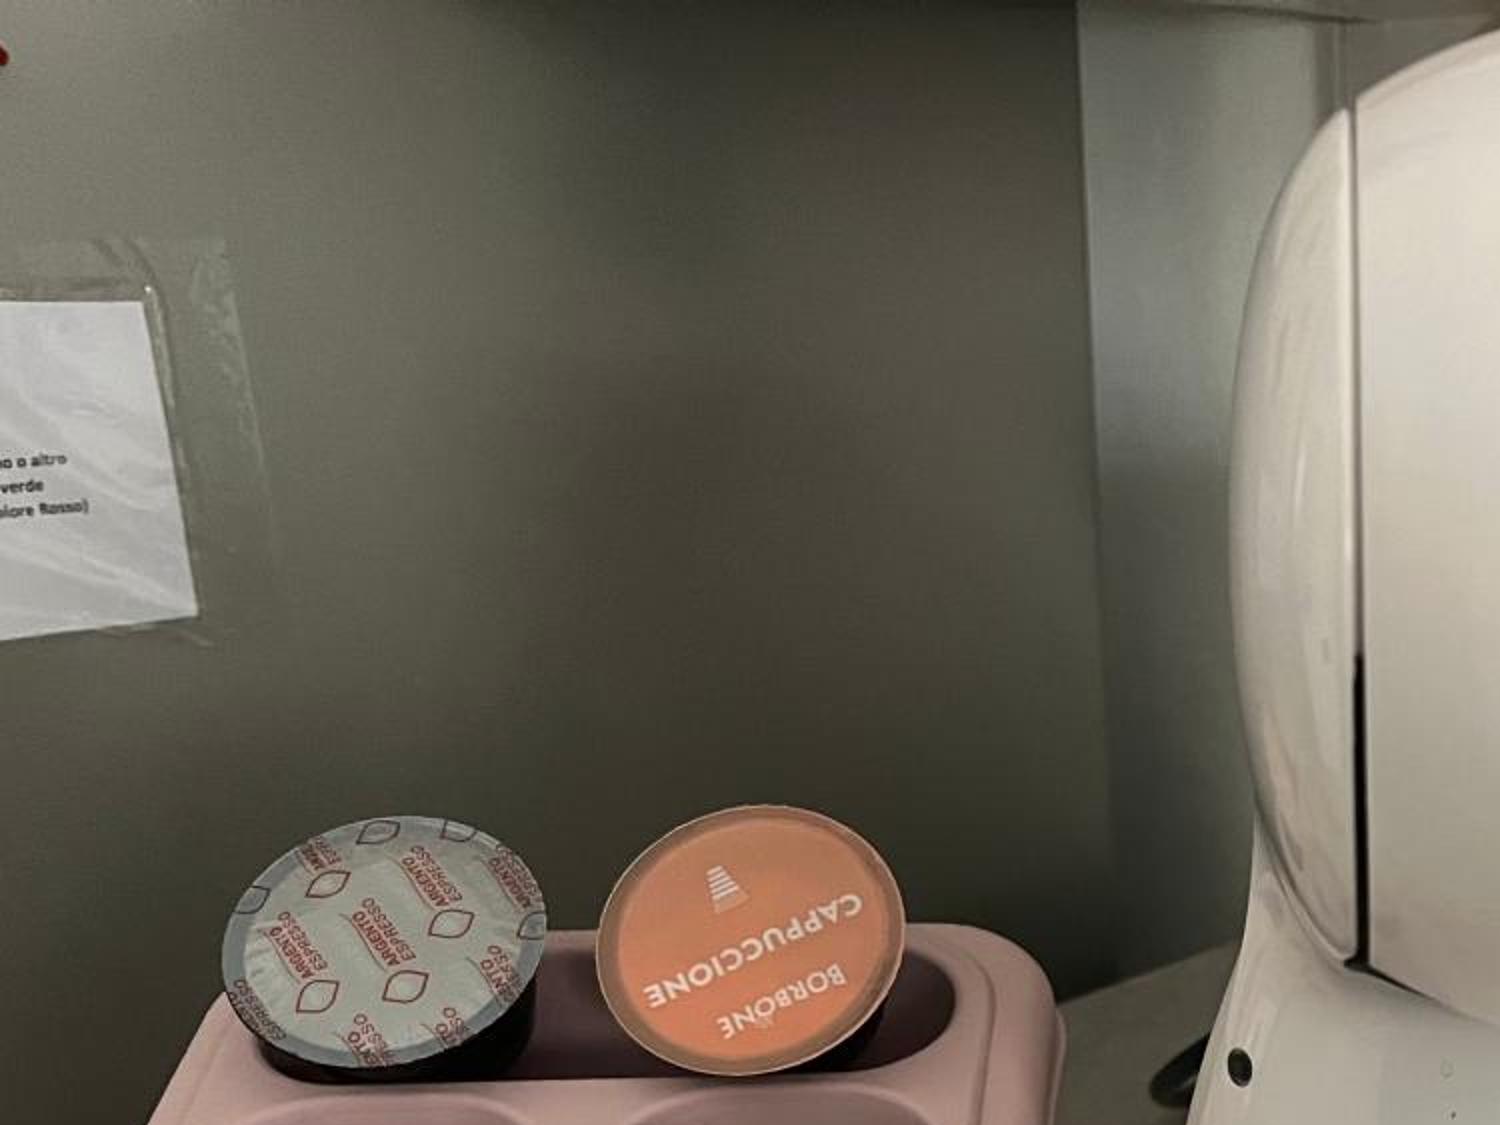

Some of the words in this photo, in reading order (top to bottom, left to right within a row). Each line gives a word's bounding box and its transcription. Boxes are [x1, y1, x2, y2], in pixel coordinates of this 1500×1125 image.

[402, 857, 450, 907] ARGENTO
[411, 845, 463, 901] ESPRESSO
[270, 926, 316, 979] ARGENTO
[352, 910, 401, 966] ARGENTO
[362, 897, 417, 961] ESPRESSO
[643, 893, 863, 1009] CAPPUCCIONE
[716, 963, 847, 1040] BORBONE
